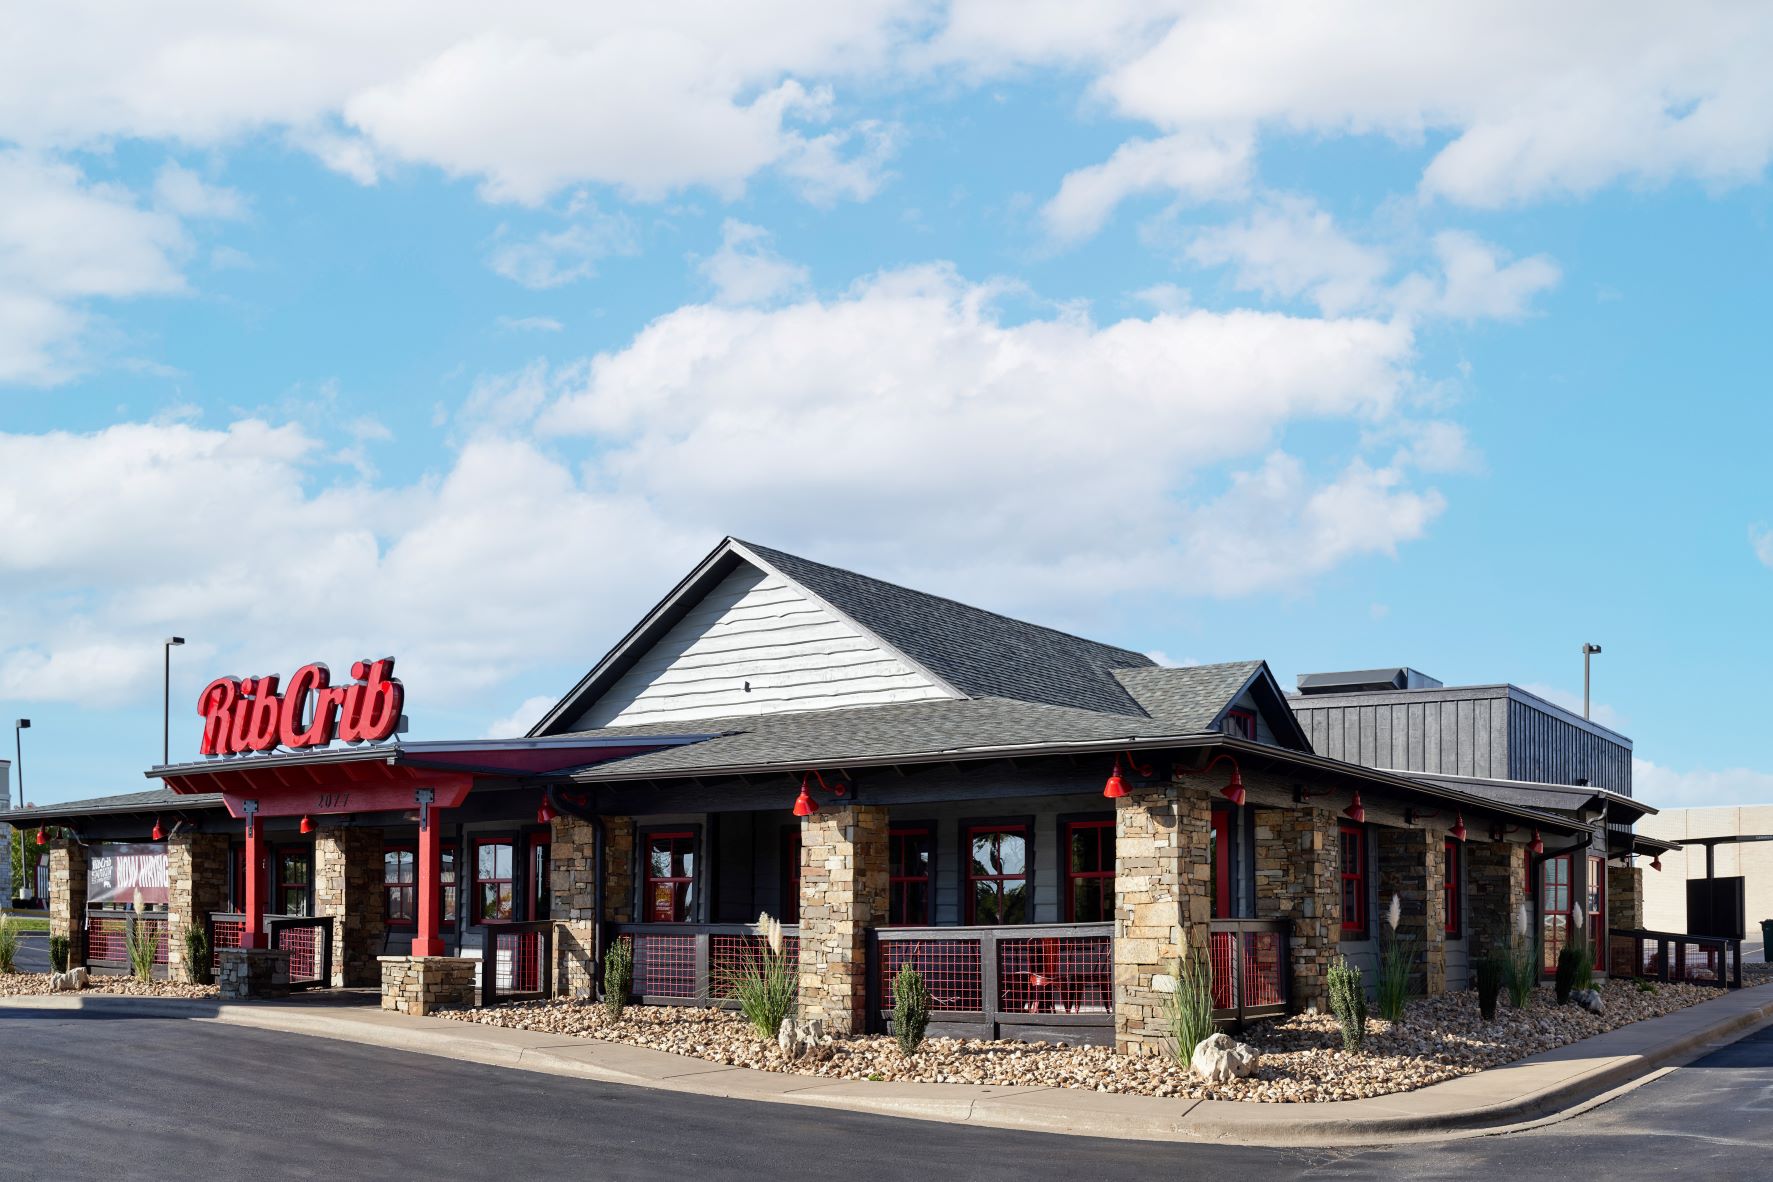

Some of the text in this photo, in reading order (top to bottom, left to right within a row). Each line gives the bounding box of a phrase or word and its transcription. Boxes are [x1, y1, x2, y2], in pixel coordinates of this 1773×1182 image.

[198, 658, 403, 756] RibCrib
[117, 855, 169, 888] NOW HIRING
